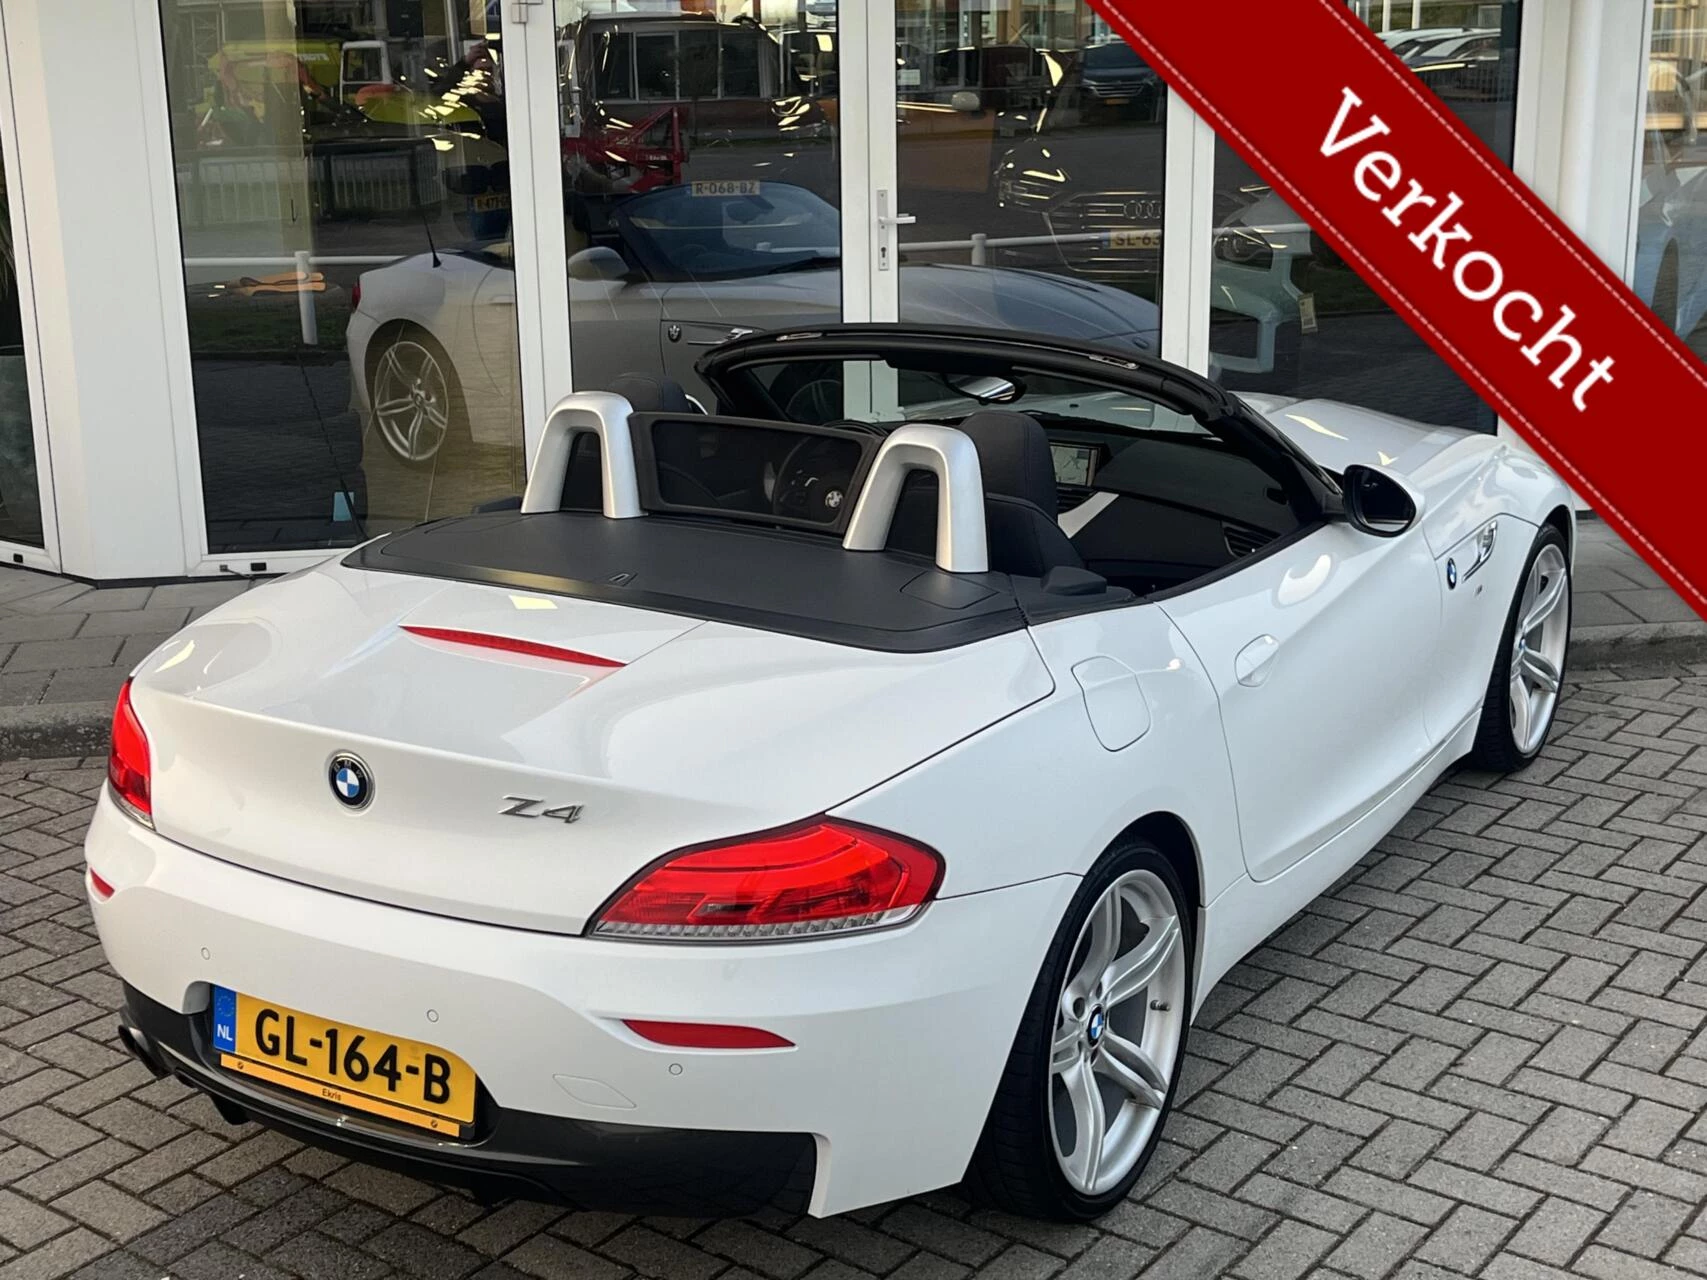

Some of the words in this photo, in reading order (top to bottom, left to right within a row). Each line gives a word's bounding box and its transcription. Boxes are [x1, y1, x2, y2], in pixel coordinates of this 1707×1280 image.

[498, 795, 584, 823] Z4
[216, 1023, 234, 1042] NL
[254, 1007, 451, 1104] GL-164-B
[321, 1086, 342, 1102] Ekris
